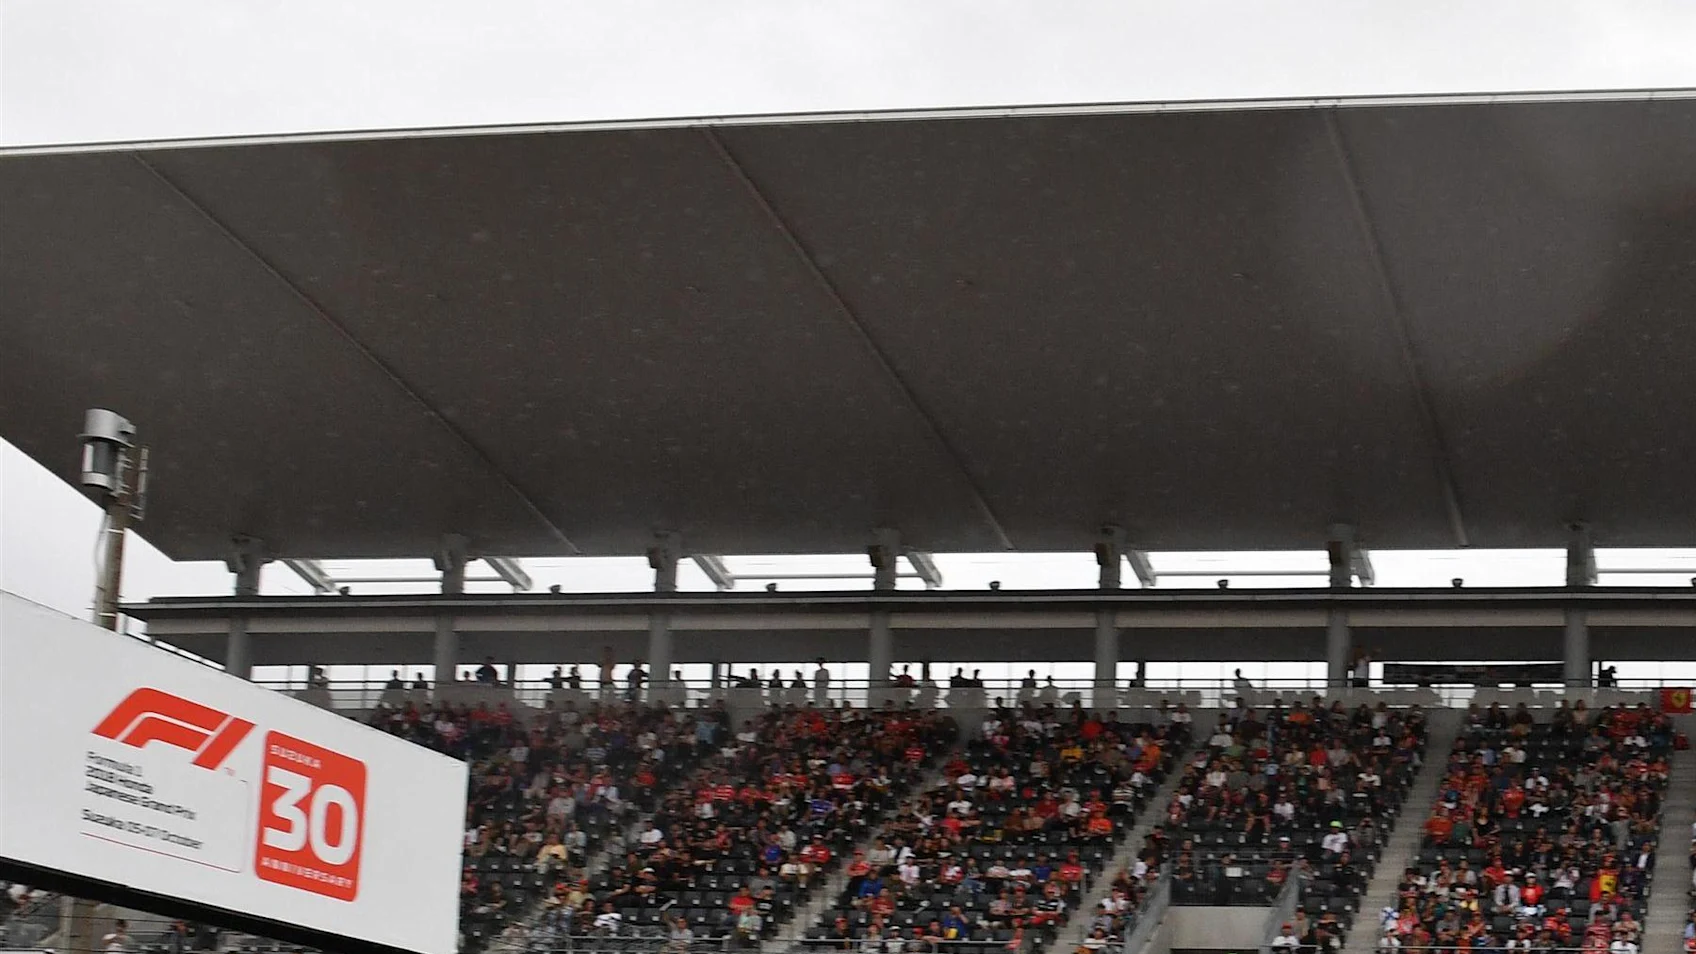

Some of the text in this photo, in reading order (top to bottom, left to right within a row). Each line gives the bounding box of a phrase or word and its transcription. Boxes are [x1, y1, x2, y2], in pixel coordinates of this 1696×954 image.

[86, 751, 133, 775] Formula
[270, 744, 323, 769] SUZUKA
[263, 765, 359, 866] 30
[260, 856, 354, 889] ANNIVERSARY
